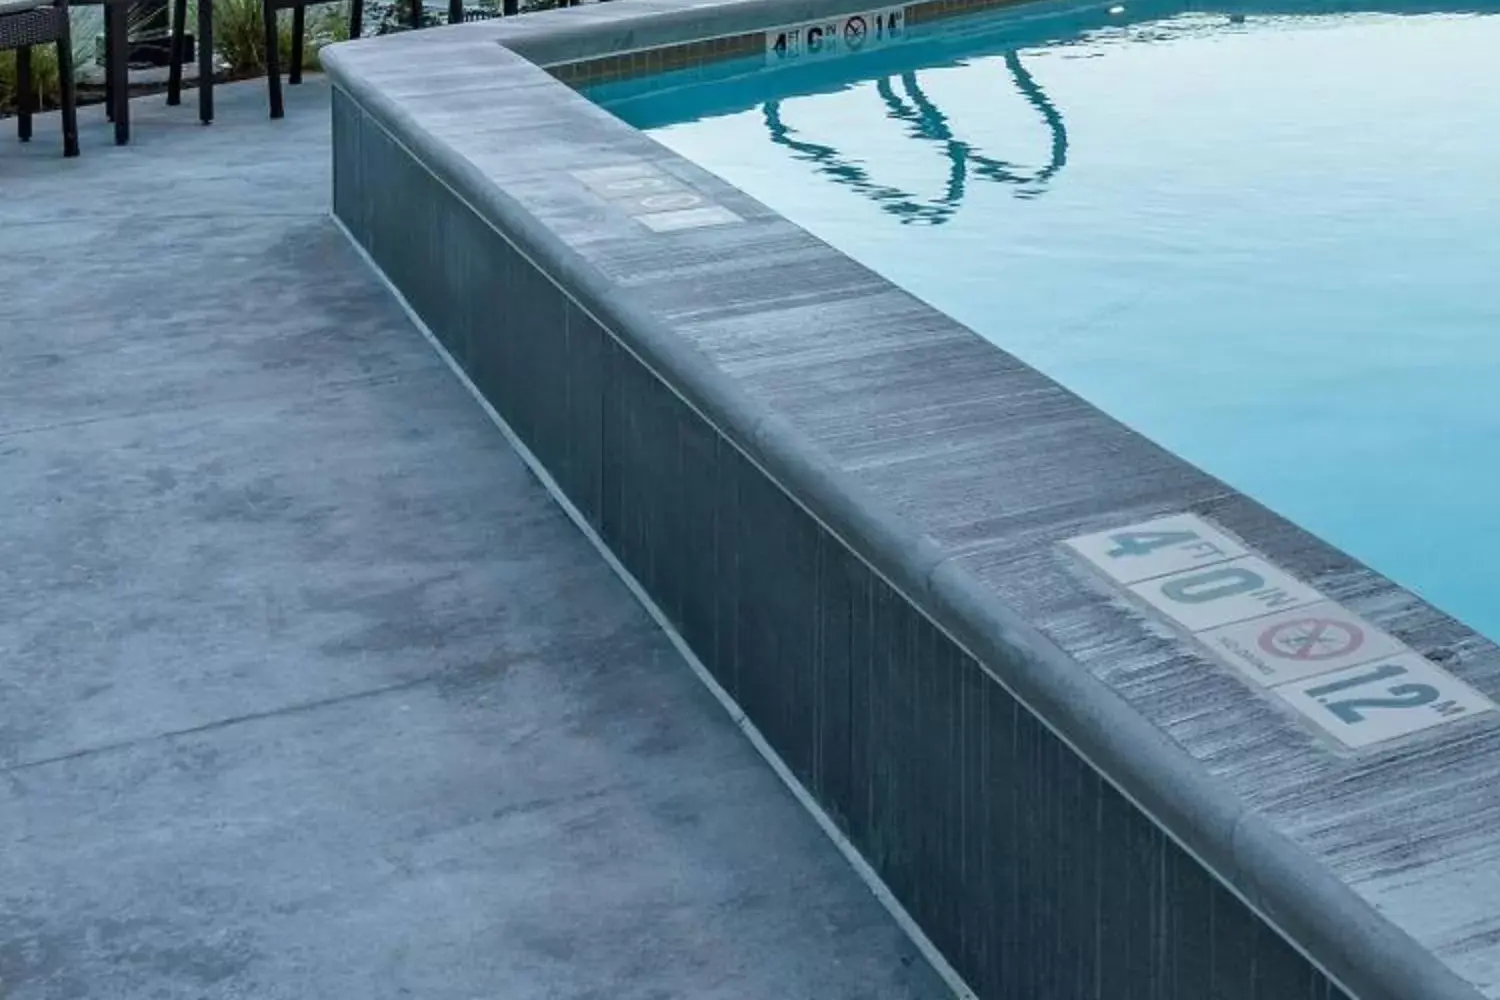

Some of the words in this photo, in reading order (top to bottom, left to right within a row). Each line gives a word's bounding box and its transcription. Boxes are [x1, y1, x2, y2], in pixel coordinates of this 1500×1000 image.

[1104, 529, 1201, 559] 4
[1178, 541, 1228, 559] FT
[1160, 567, 1265, 603] 0
[1250, 587, 1298, 608] IN
[1429, 699, 1467, 717] M
